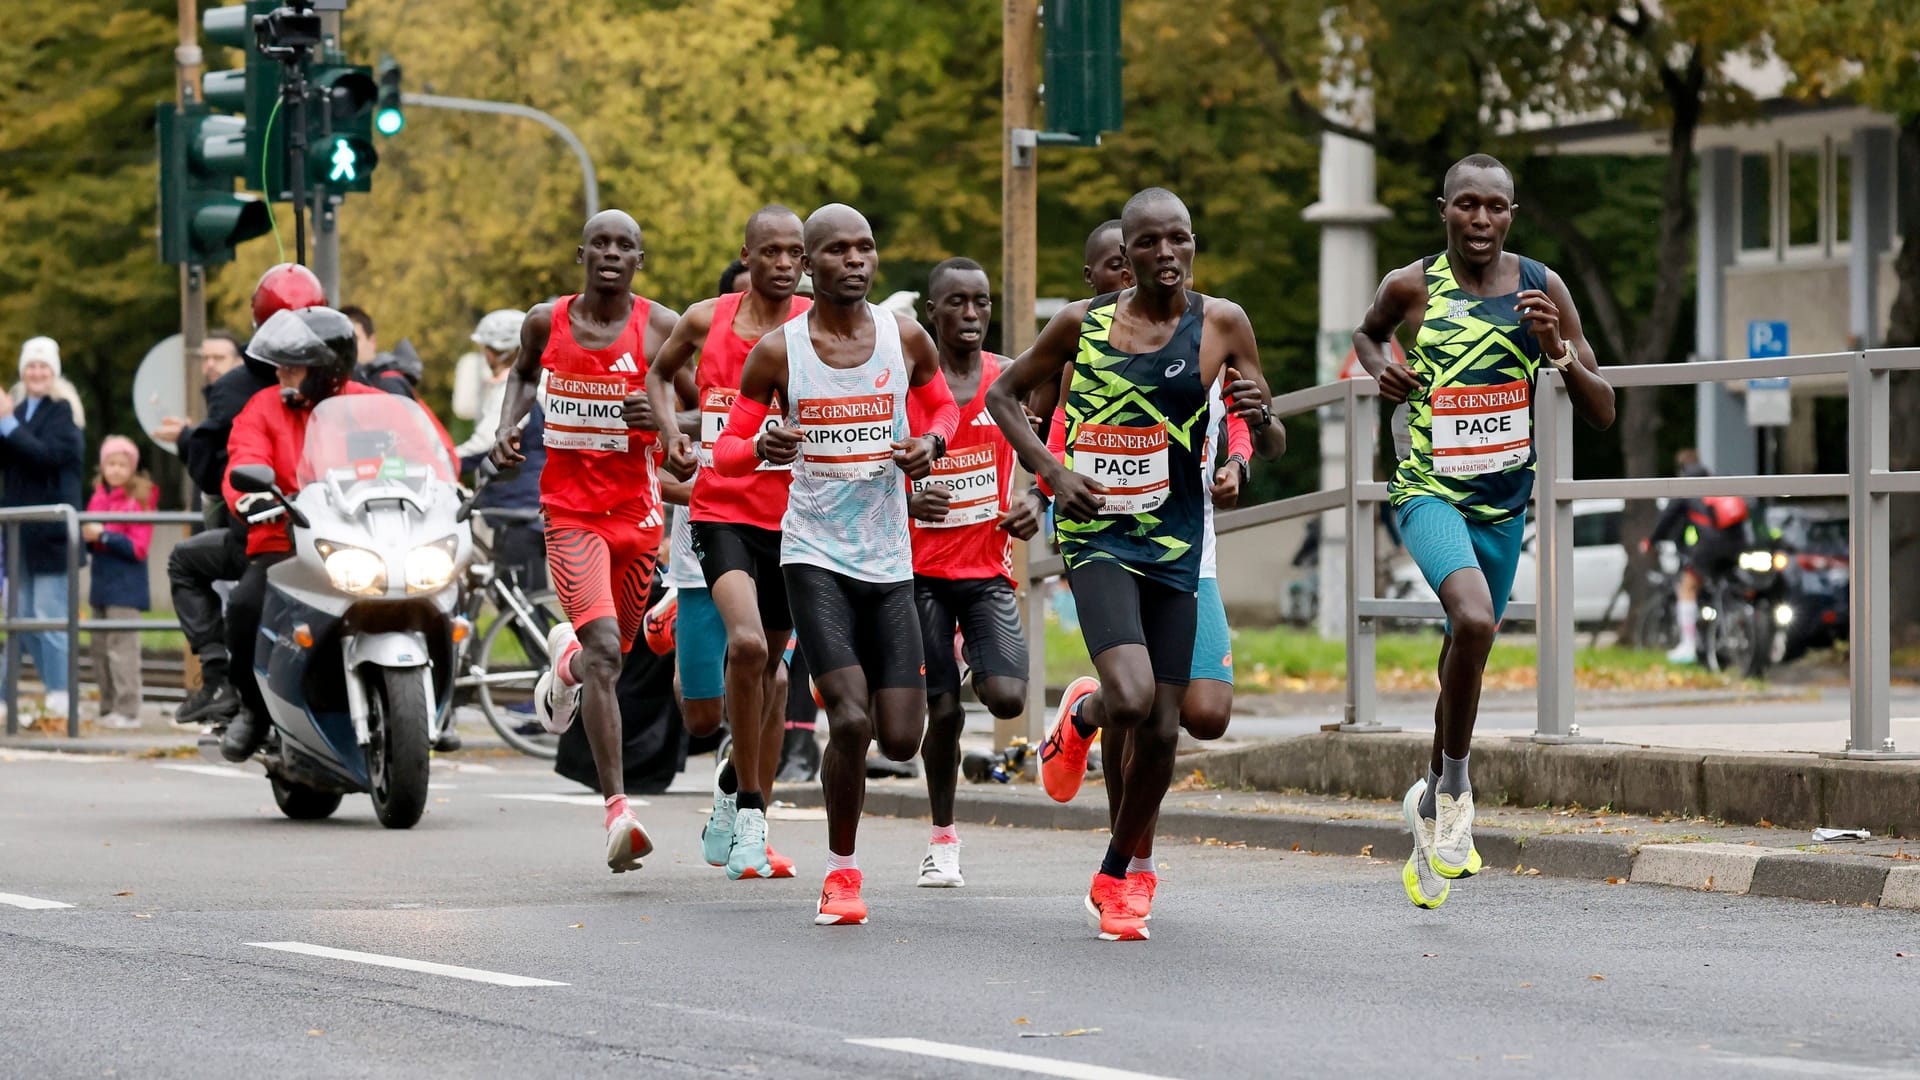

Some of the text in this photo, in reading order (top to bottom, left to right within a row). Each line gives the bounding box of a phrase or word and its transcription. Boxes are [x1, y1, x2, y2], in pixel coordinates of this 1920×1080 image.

[1448, 310, 1470, 319] CAMP
[563, 379, 626, 396] GENERALI
[550, 398, 623, 419] KIPLIMO
[1457, 389, 1527, 409] GENERALI
[821, 399, 891, 419] GENERALI
[803, 425, 892, 444] KIPKOECH
[1455, 415, 1511, 436] PACE
[1097, 430, 1166, 449] GENERALI
[1480, 436, 1488, 444] 71
[846, 446, 852, 454] 3
[932, 449, 993, 471] GENERALI
[1094, 457, 1151, 476] PACE
[1457, 463, 1488, 473] MARATHON
[1117, 478, 1128, 486] 72
[1142, 500, 1159, 510] PUMA
